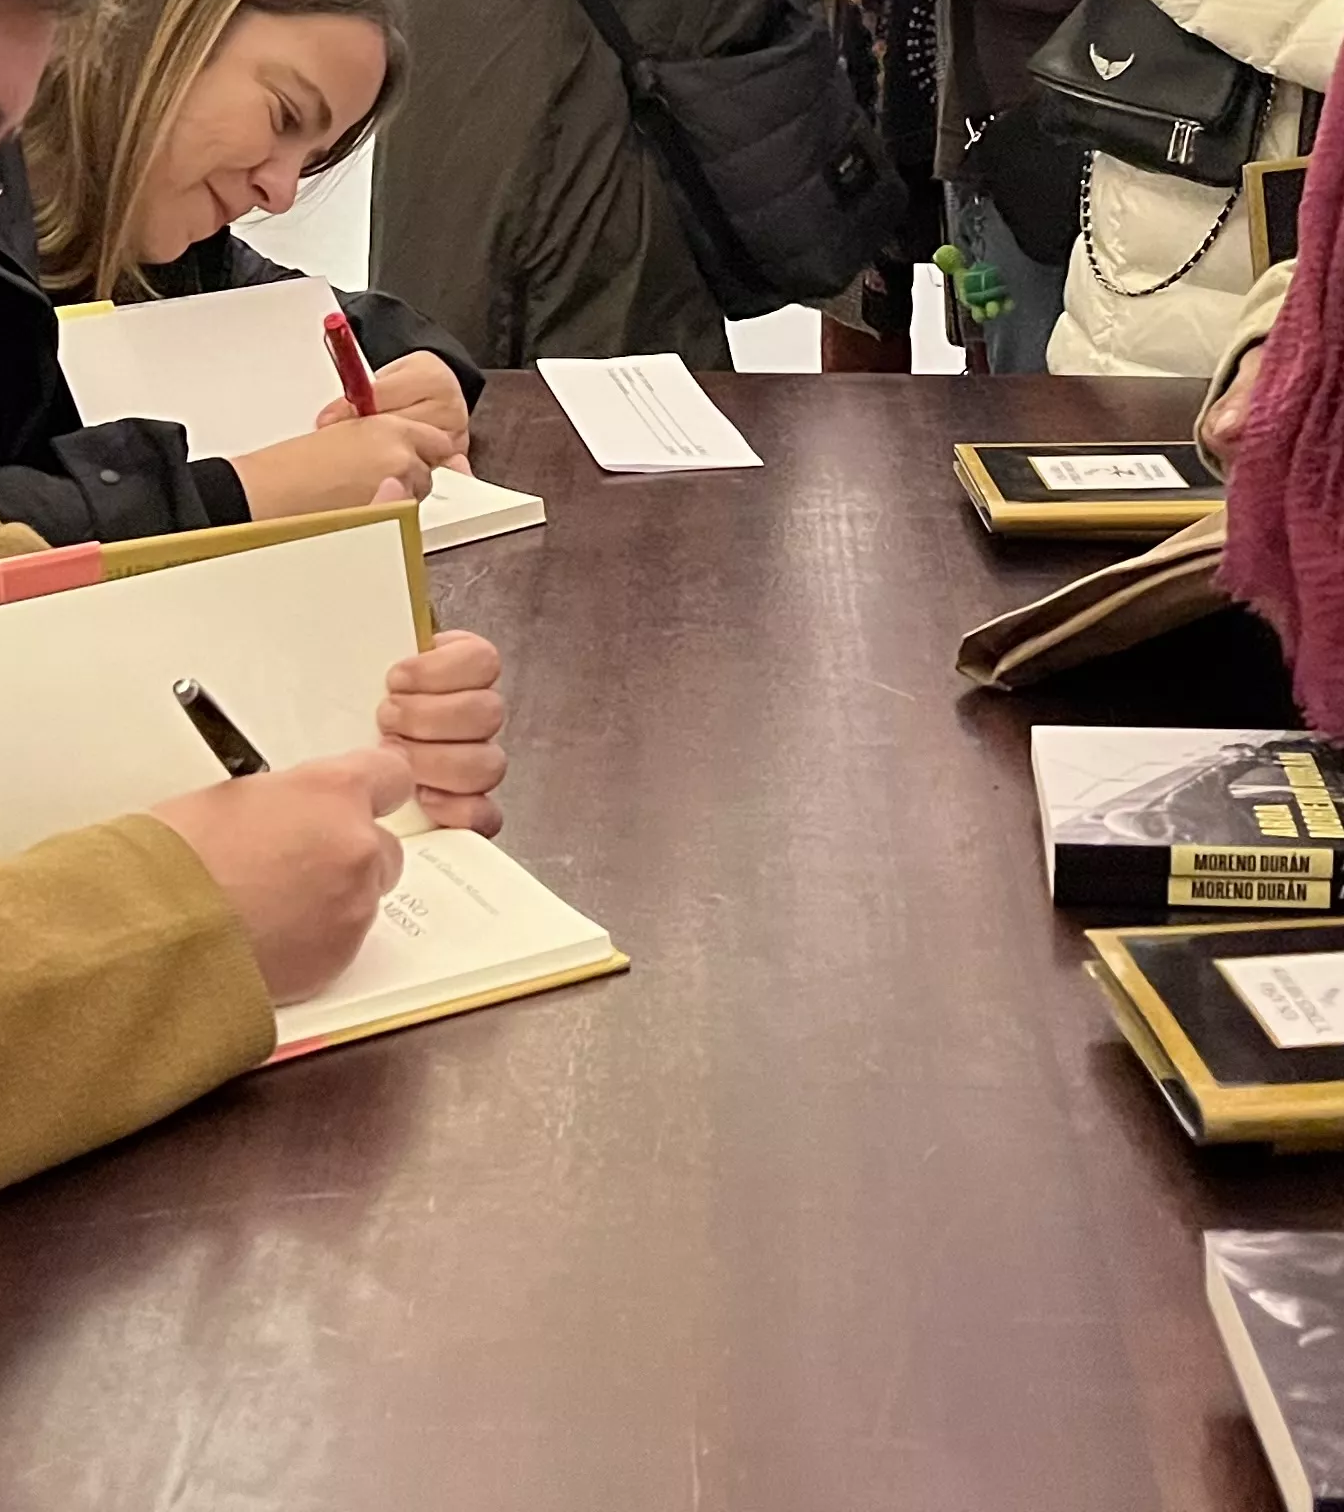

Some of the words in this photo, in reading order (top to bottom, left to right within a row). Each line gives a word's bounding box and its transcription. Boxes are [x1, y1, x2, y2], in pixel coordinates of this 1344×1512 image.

[1193, 853, 1257, 873] MORENO
[1259, 851, 1310, 873] DURÁN
[1191, 880, 1254, 900] MORENO
[1257, 879, 1307, 901] DURÁN
